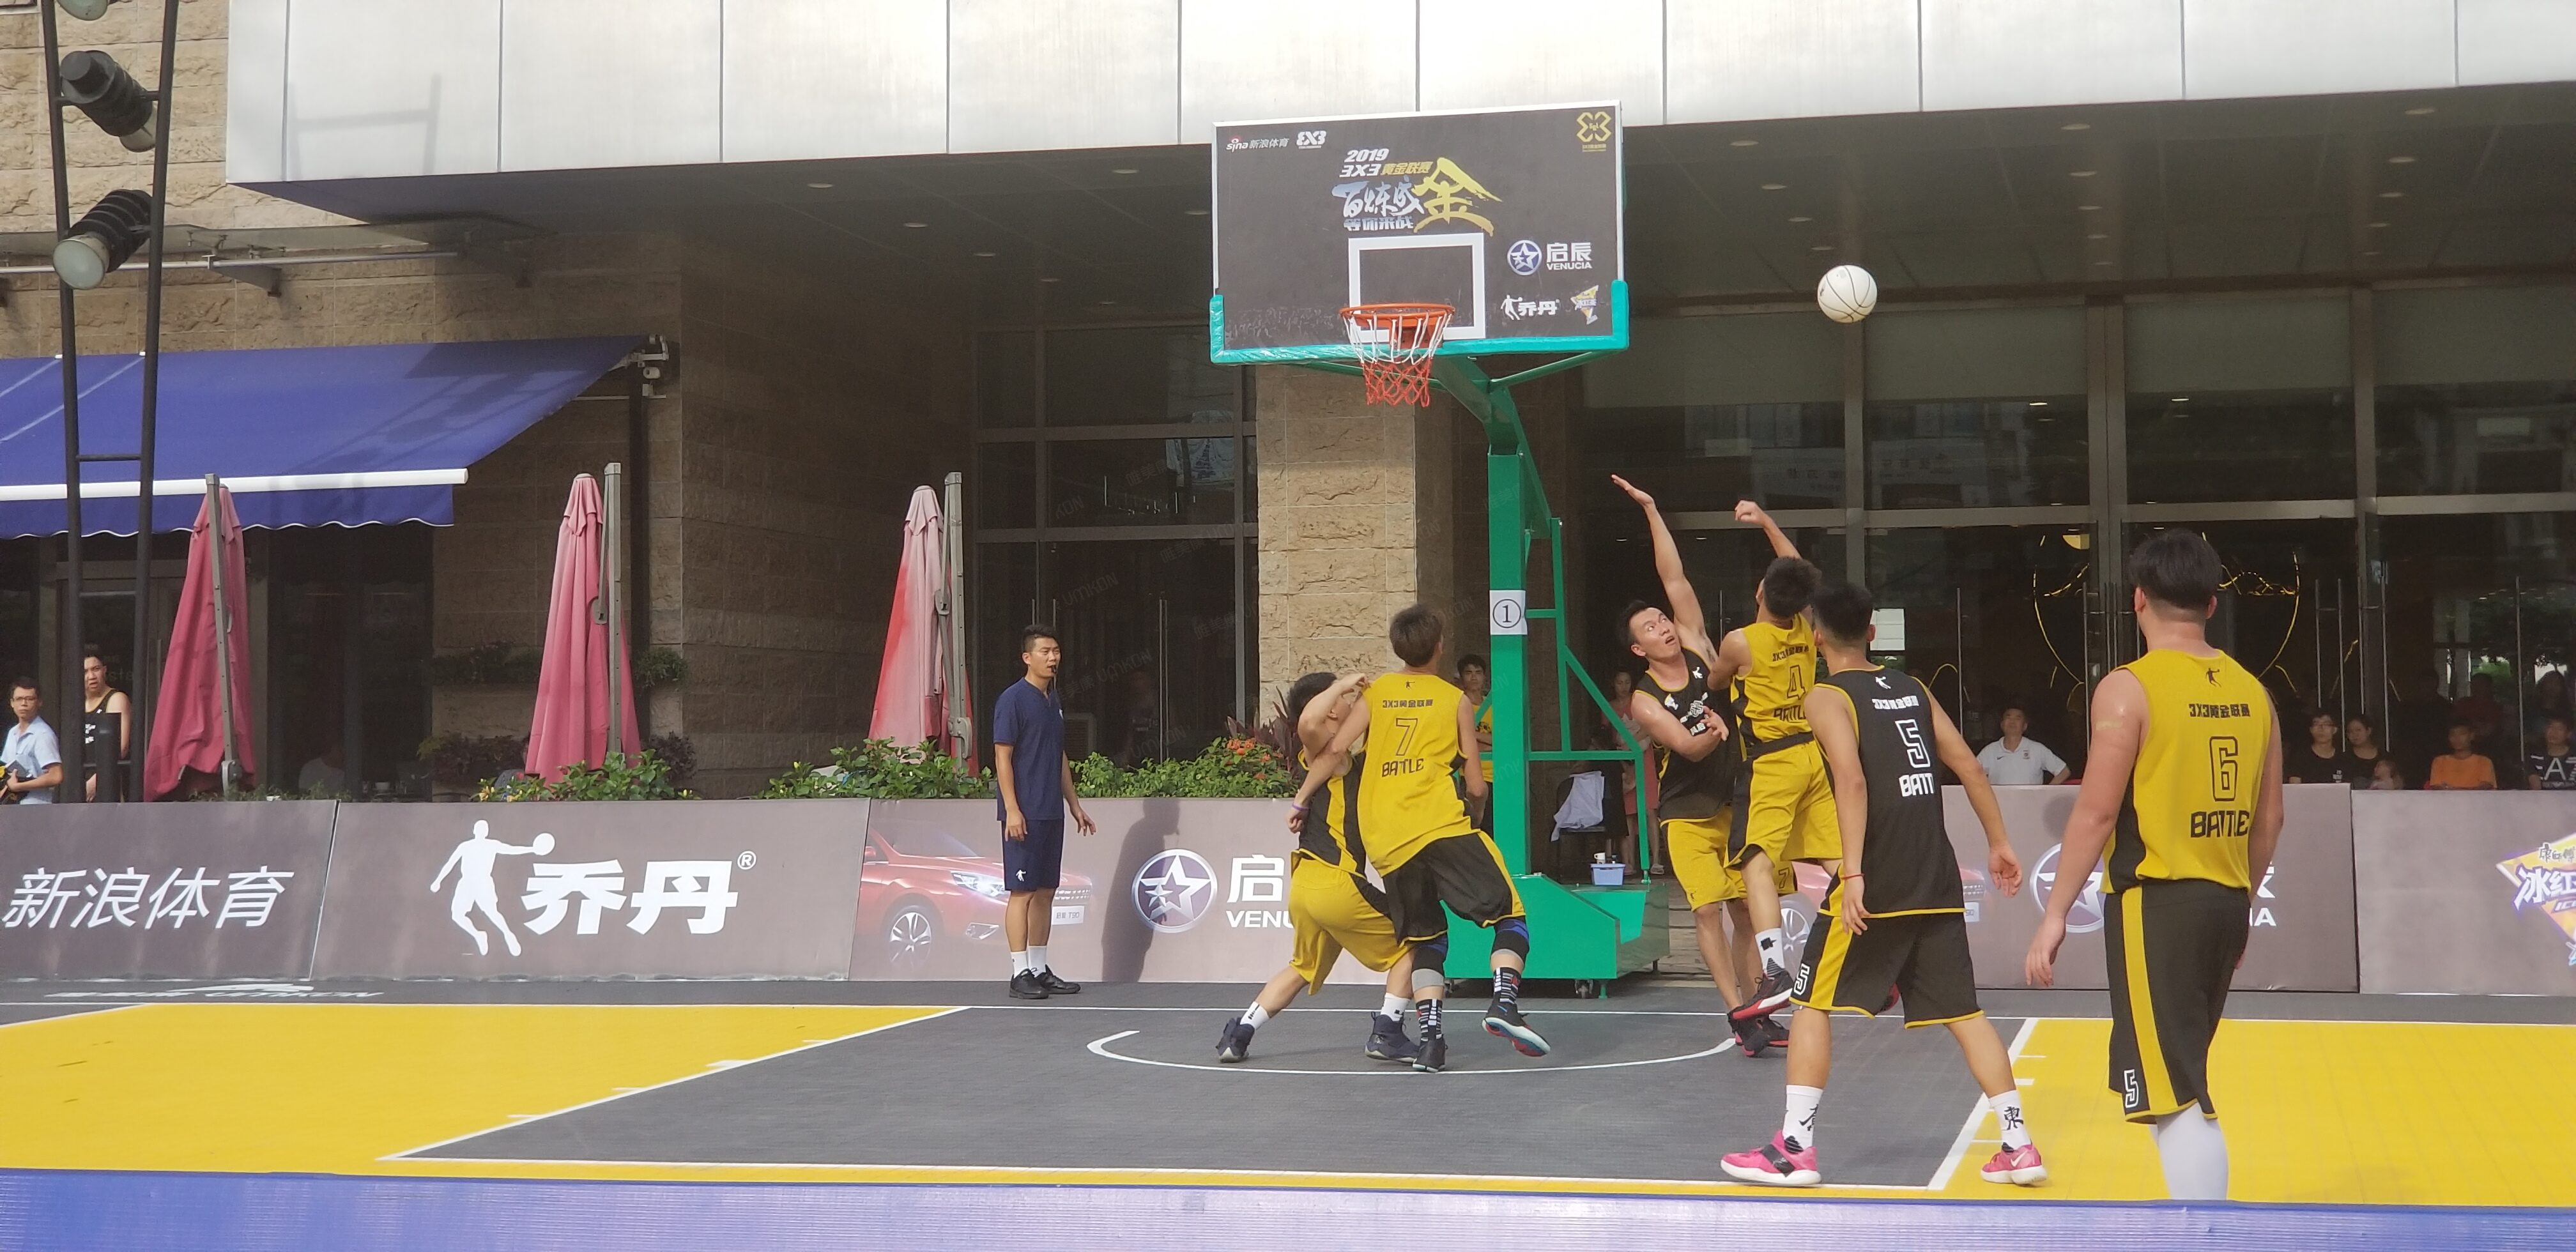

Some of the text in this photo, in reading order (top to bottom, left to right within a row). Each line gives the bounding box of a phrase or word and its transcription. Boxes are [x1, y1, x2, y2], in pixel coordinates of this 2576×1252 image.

[1249, 138, 1289, 149] 新浪体育
[1344, 148, 1390, 162] 2019
[1339, 161, 1434, 178] 3X3 黄金联赛
[1546, 242, 1592, 263] 启辰
[1546, 263, 1593, 271] VENUCIA
[1517, 300, 1558, 316] 乔丹
[1786, 664, 1806, 700] 4
[1395, 717, 1418, 756] 7
[1895, 719, 1931, 768] 5
[2209, 736, 2238, 802] 6
[1227, 854, 1285, 903] 启
[1778, 867, 1790, 889] 7
[1, 865, 295, 929] 新浪体育
[521, 859, 739, 935] 乔丹
[1793, 963, 1810, 996] 5
[2124, 1069, 2139, 1108] 5
